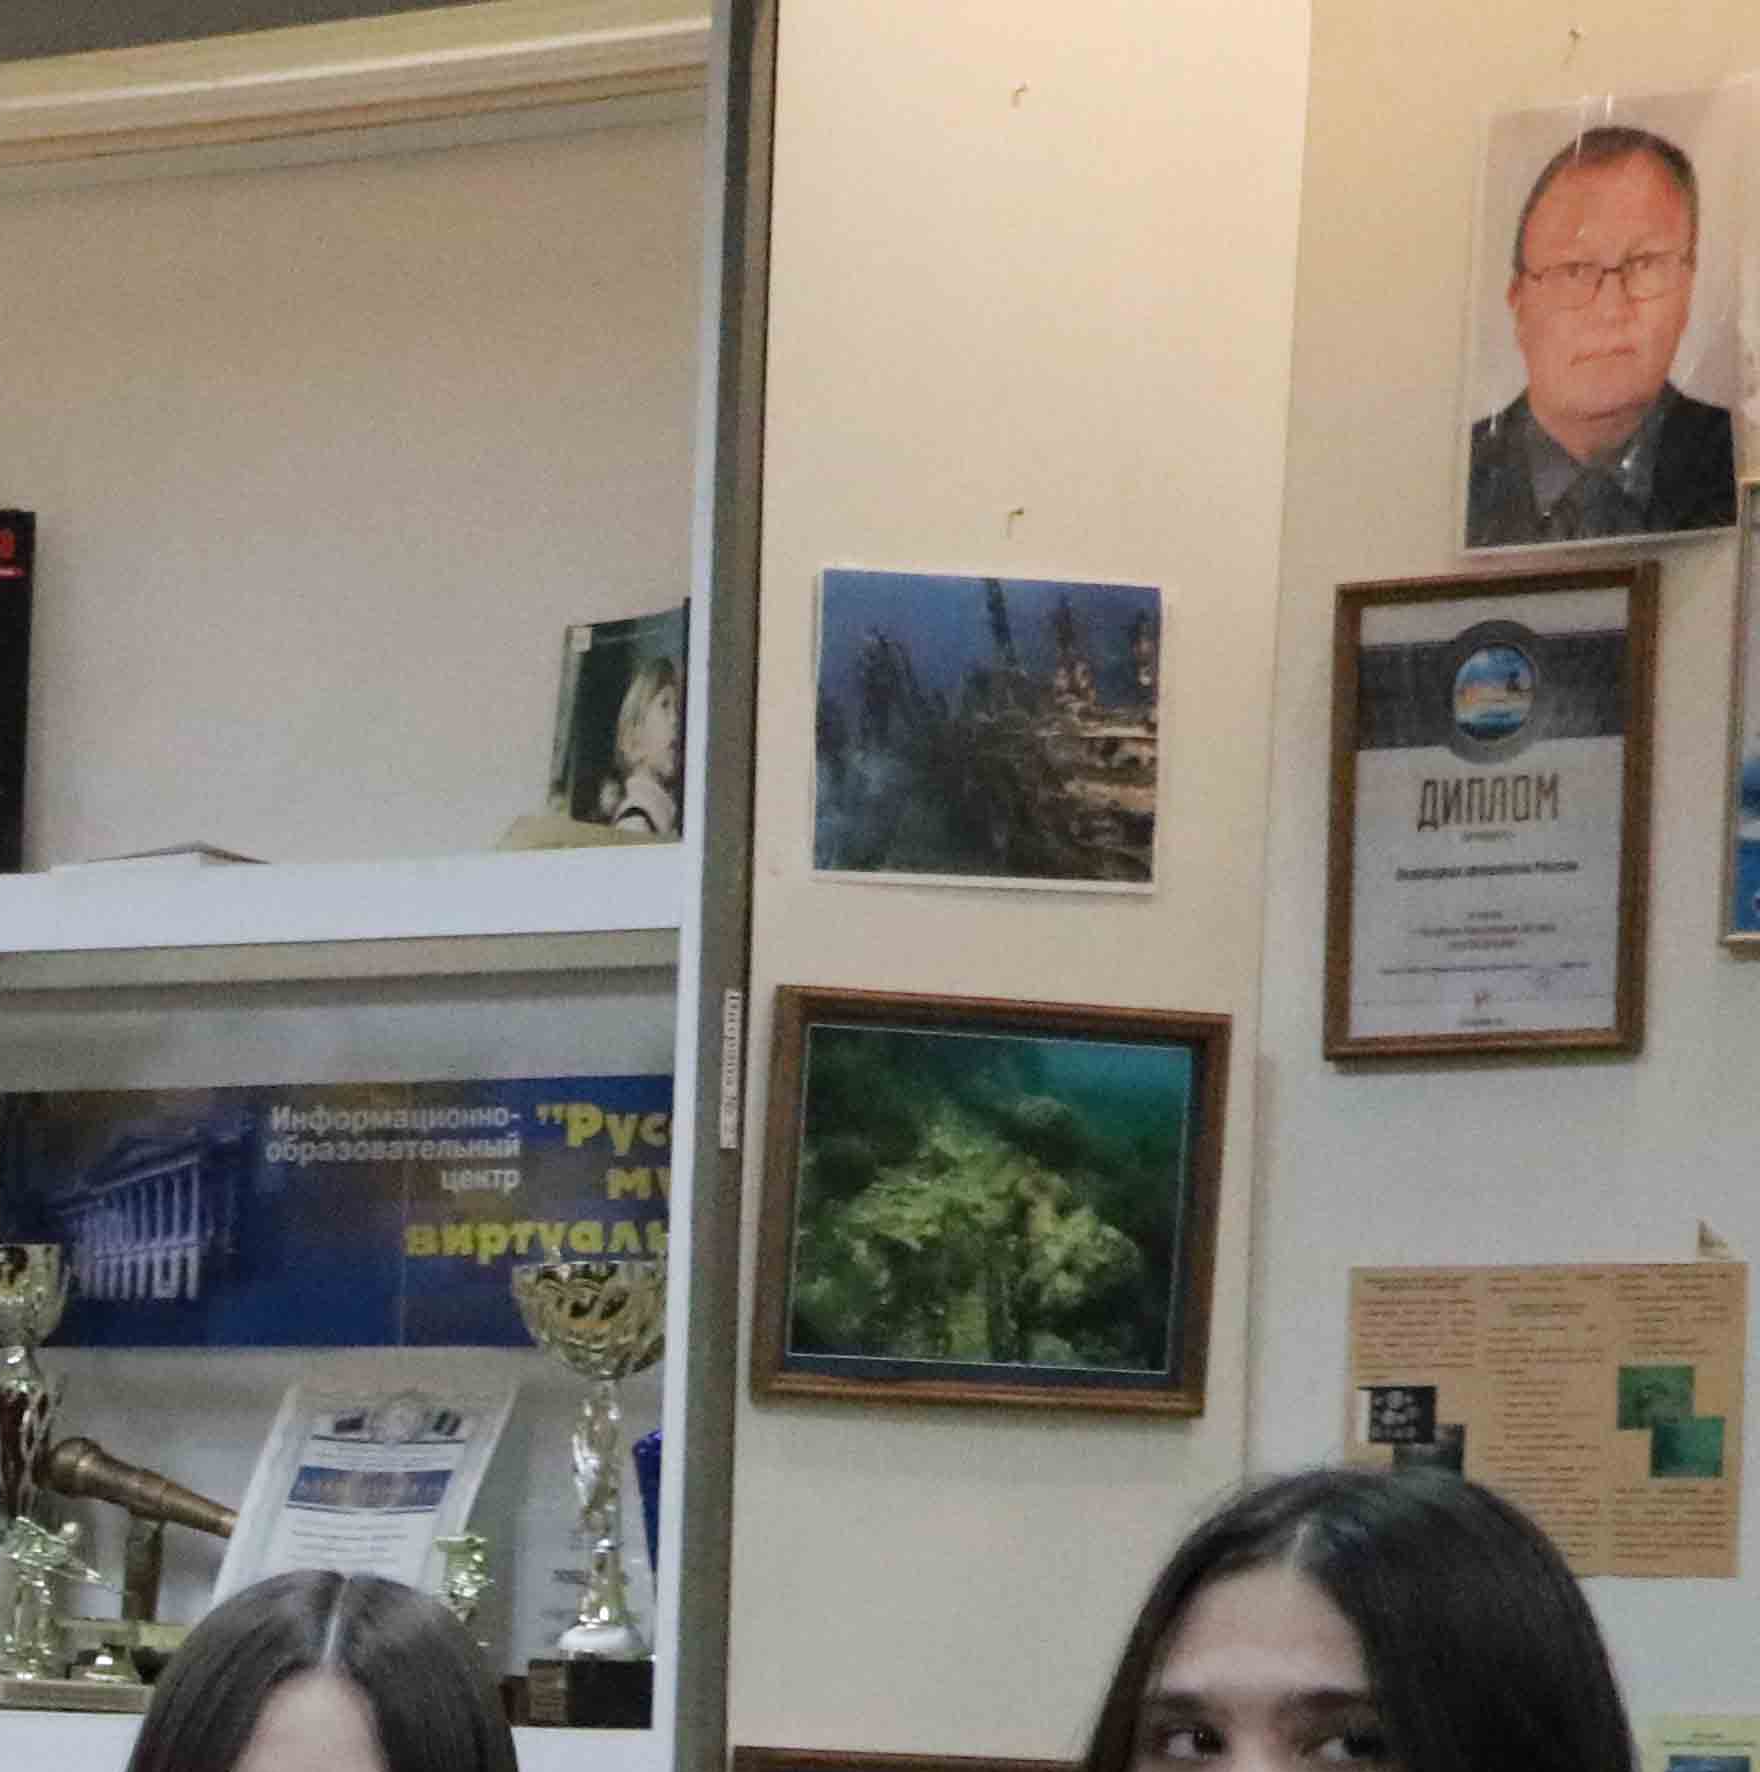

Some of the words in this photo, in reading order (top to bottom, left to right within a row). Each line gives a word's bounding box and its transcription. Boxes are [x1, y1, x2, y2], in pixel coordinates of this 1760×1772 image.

[1417, 773, 1560, 833] ДИПЛОМ
[270, 1104, 520, 1134] Информационно-
[266, 1133, 521, 1164] образовательный
[440, 1168, 521, 1196] центр
